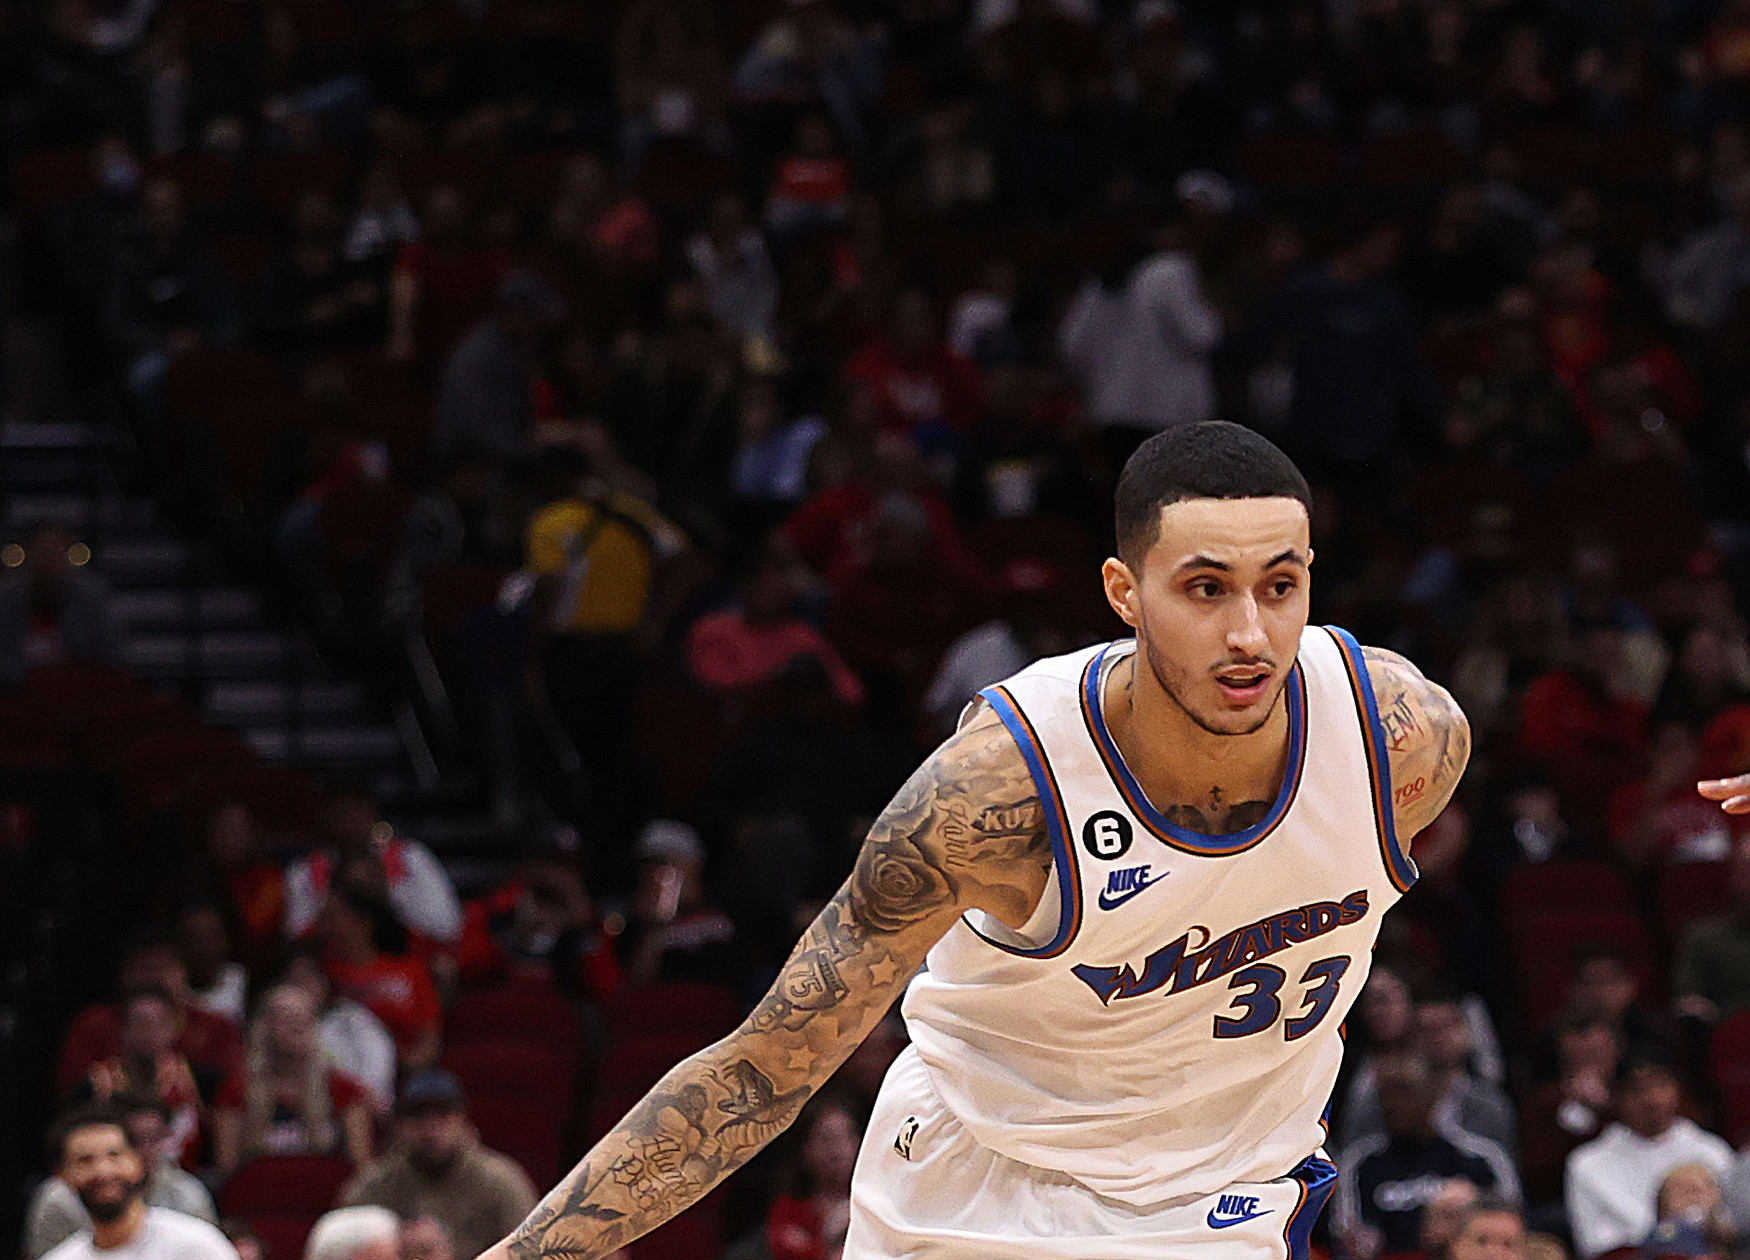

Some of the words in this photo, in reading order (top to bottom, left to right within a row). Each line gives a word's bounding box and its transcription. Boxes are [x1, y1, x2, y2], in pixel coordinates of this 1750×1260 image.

[1094, 817, 1122, 855] 6
[1106, 864, 1152, 894] NIKE
[1213, 955, 1351, 1042] 33
[1216, 1194, 1260, 1216] NIKE
